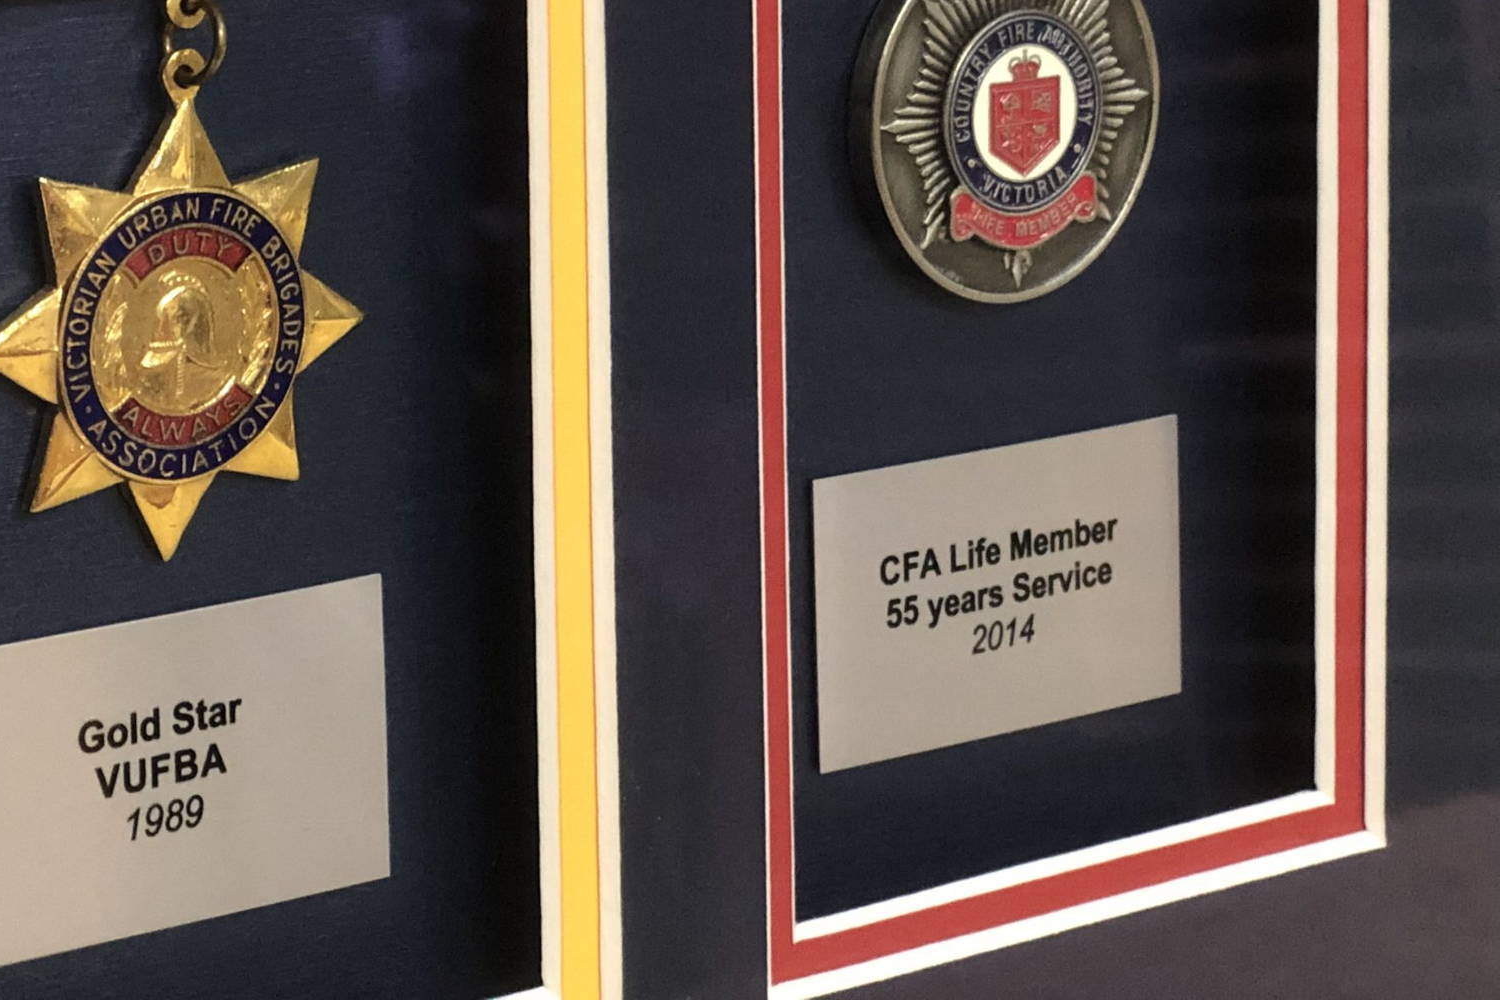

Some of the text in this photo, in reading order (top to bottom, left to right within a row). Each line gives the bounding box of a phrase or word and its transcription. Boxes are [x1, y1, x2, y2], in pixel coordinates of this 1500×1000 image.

[953, 43, 993, 144] COUNTRY
[998, 21, 1035, 48] FIRE
[981, 166, 1068, 203] VICTORIA
[1015, 193, 1076, 237] MEMBER
[148, 230, 233, 264] DUTY
[65, 197, 301, 403] VICTORIAN URBAN FIRE BRIGADES
[87, 395, 276, 478] ASSOCIATION
[121, 396, 243, 440] ALWAYS
[880, 517, 1118, 586] CFA Life Member
[886, 562, 1113, 629] 55 years Service
[972, 613, 1036, 655] 2014
[78, 698, 242, 754] Gold Star
[95, 742, 227, 799] VUFBA
[126, 794, 205, 841] 1989
